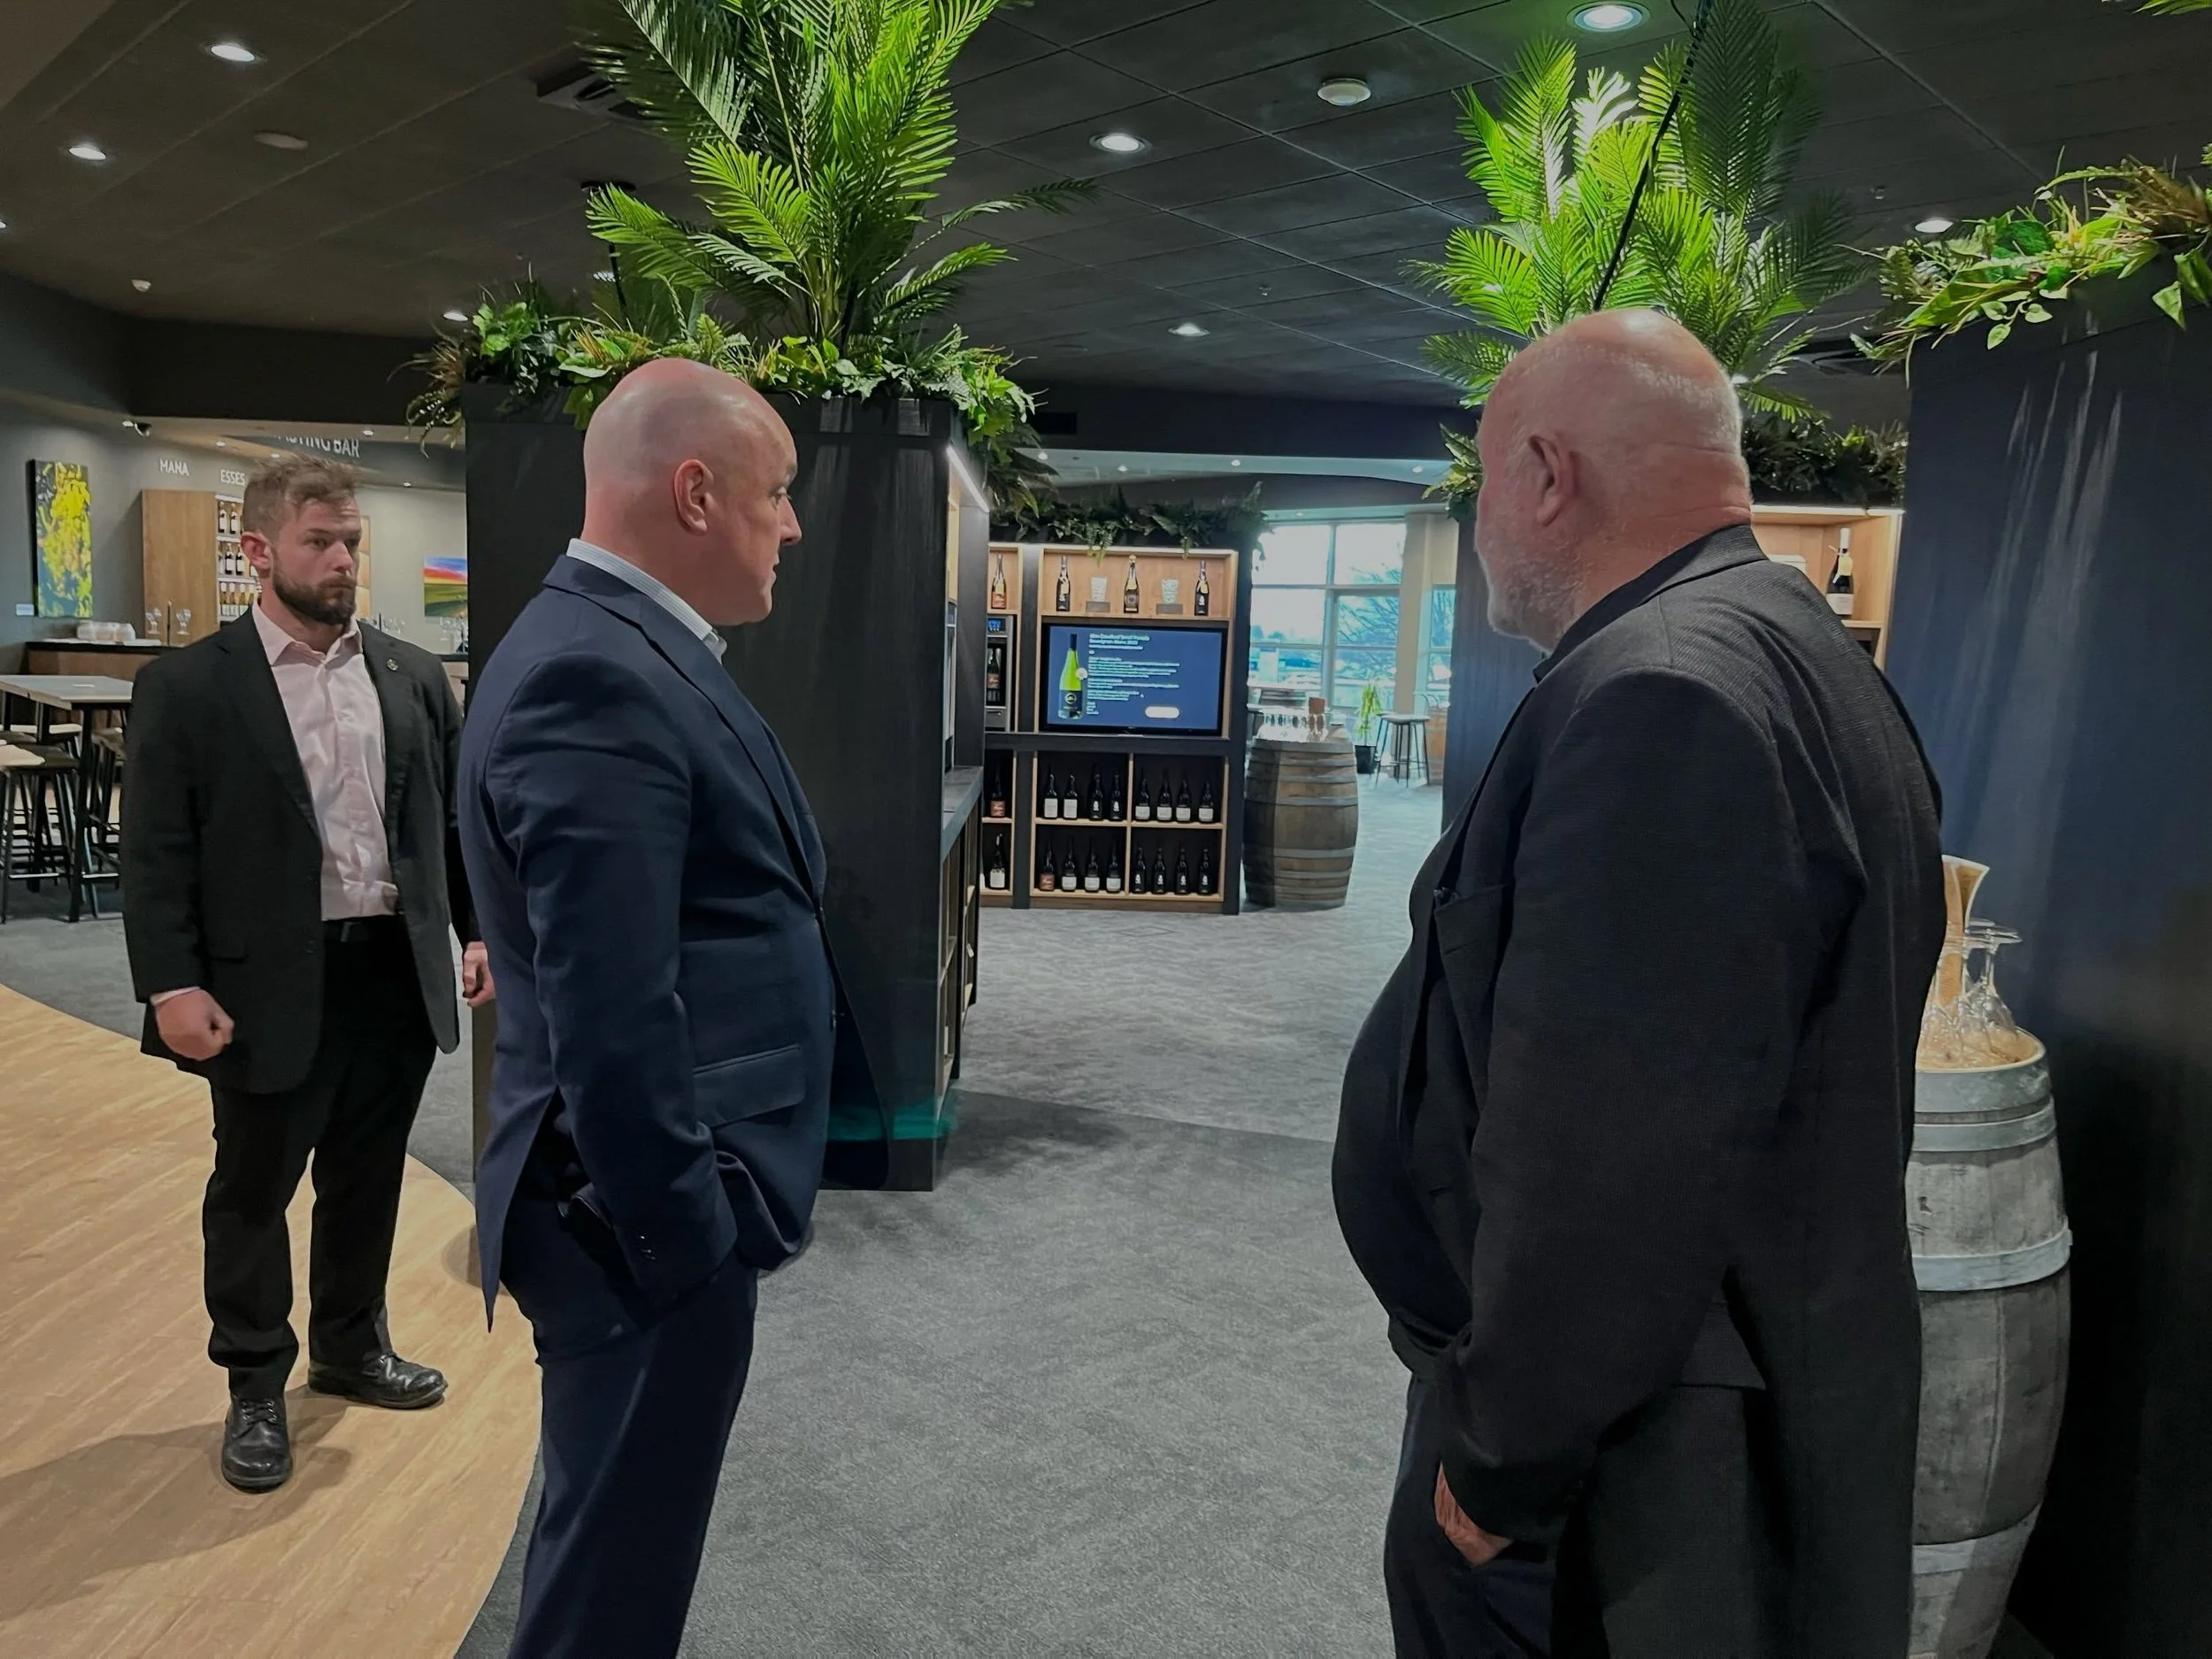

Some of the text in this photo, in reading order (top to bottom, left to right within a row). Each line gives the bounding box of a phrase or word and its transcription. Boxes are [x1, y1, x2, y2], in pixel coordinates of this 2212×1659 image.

[334, 438, 359, 458] BAR
[159, 458, 190, 477] MANA
[220, 469, 246, 486] ESSES
